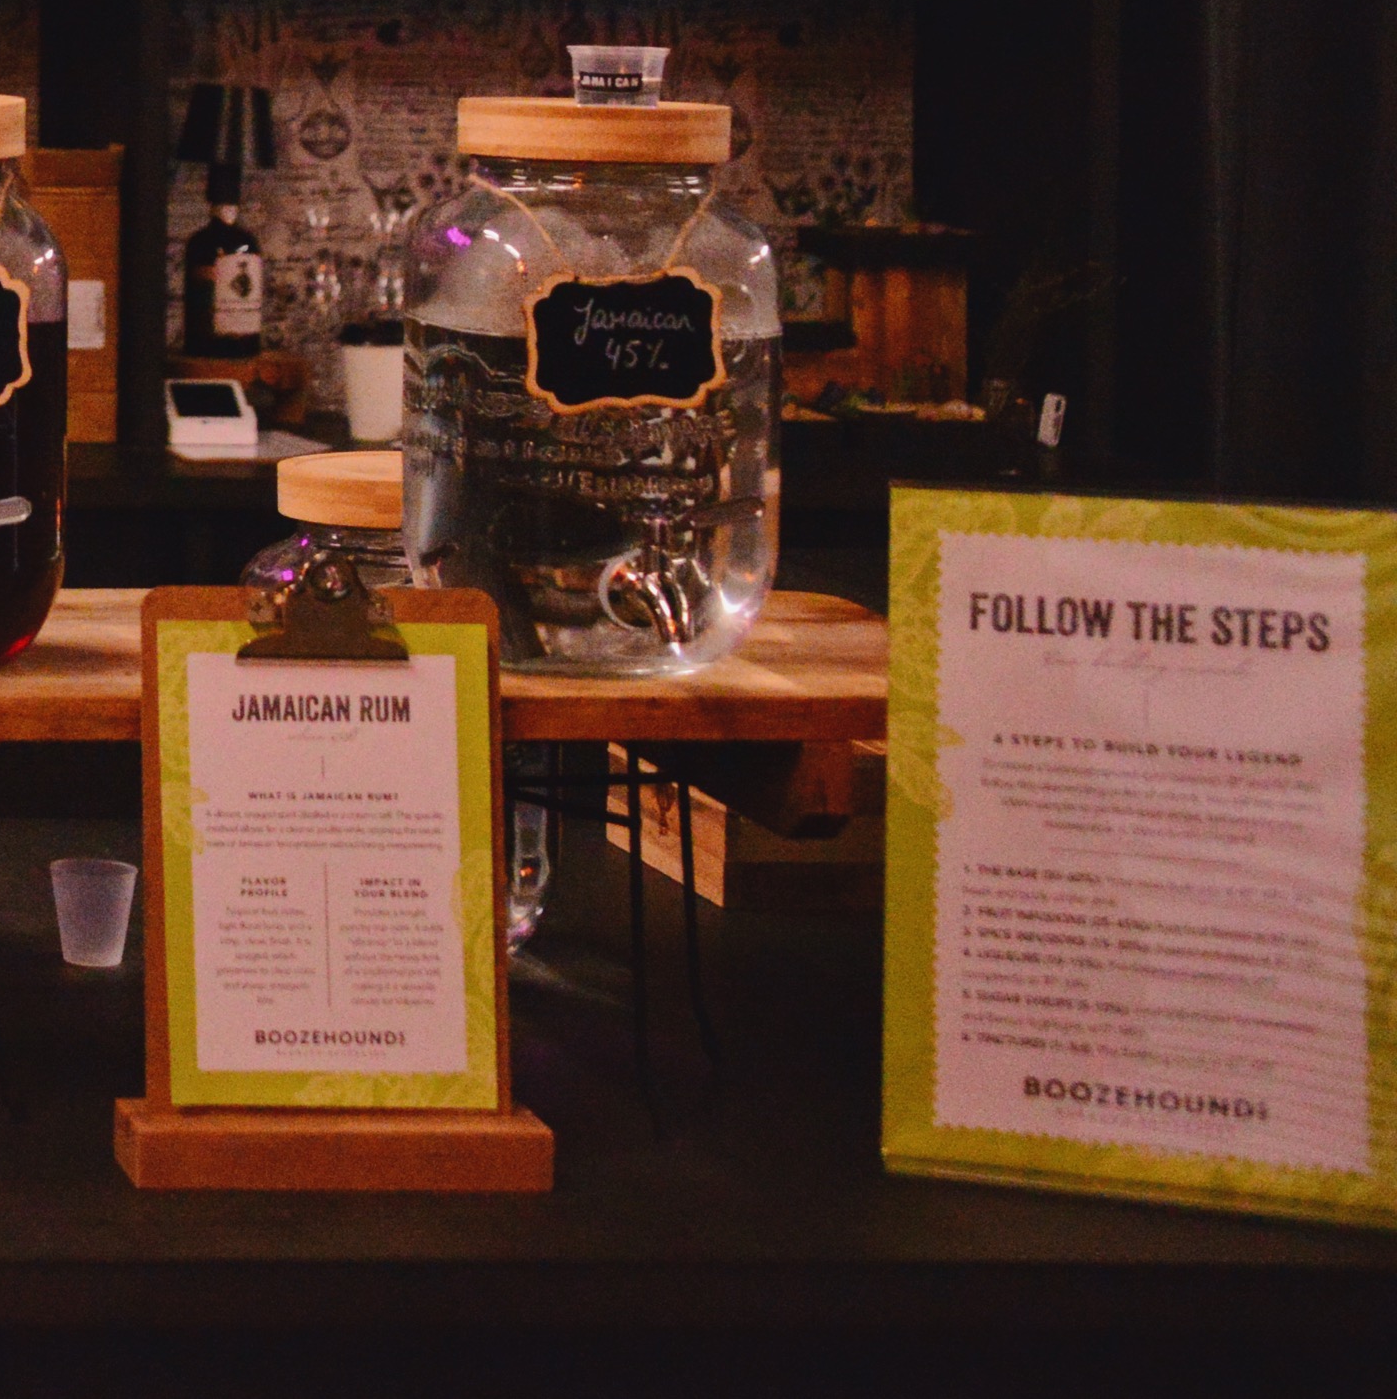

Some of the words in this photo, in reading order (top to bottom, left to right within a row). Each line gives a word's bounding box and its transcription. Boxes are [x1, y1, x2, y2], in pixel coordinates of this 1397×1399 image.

[573, 297, 696, 345] Jamaican
[968, 591, 1115, 639] FOLLOW
[1126, 600, 1198, 645] THE
[1209, 604, 1331, 653] STEPS
[232, 694, 352, 723] JAMAICAN
[359, 694, 411, 723] RUM
[1071, 737, 1097, 751] TO
